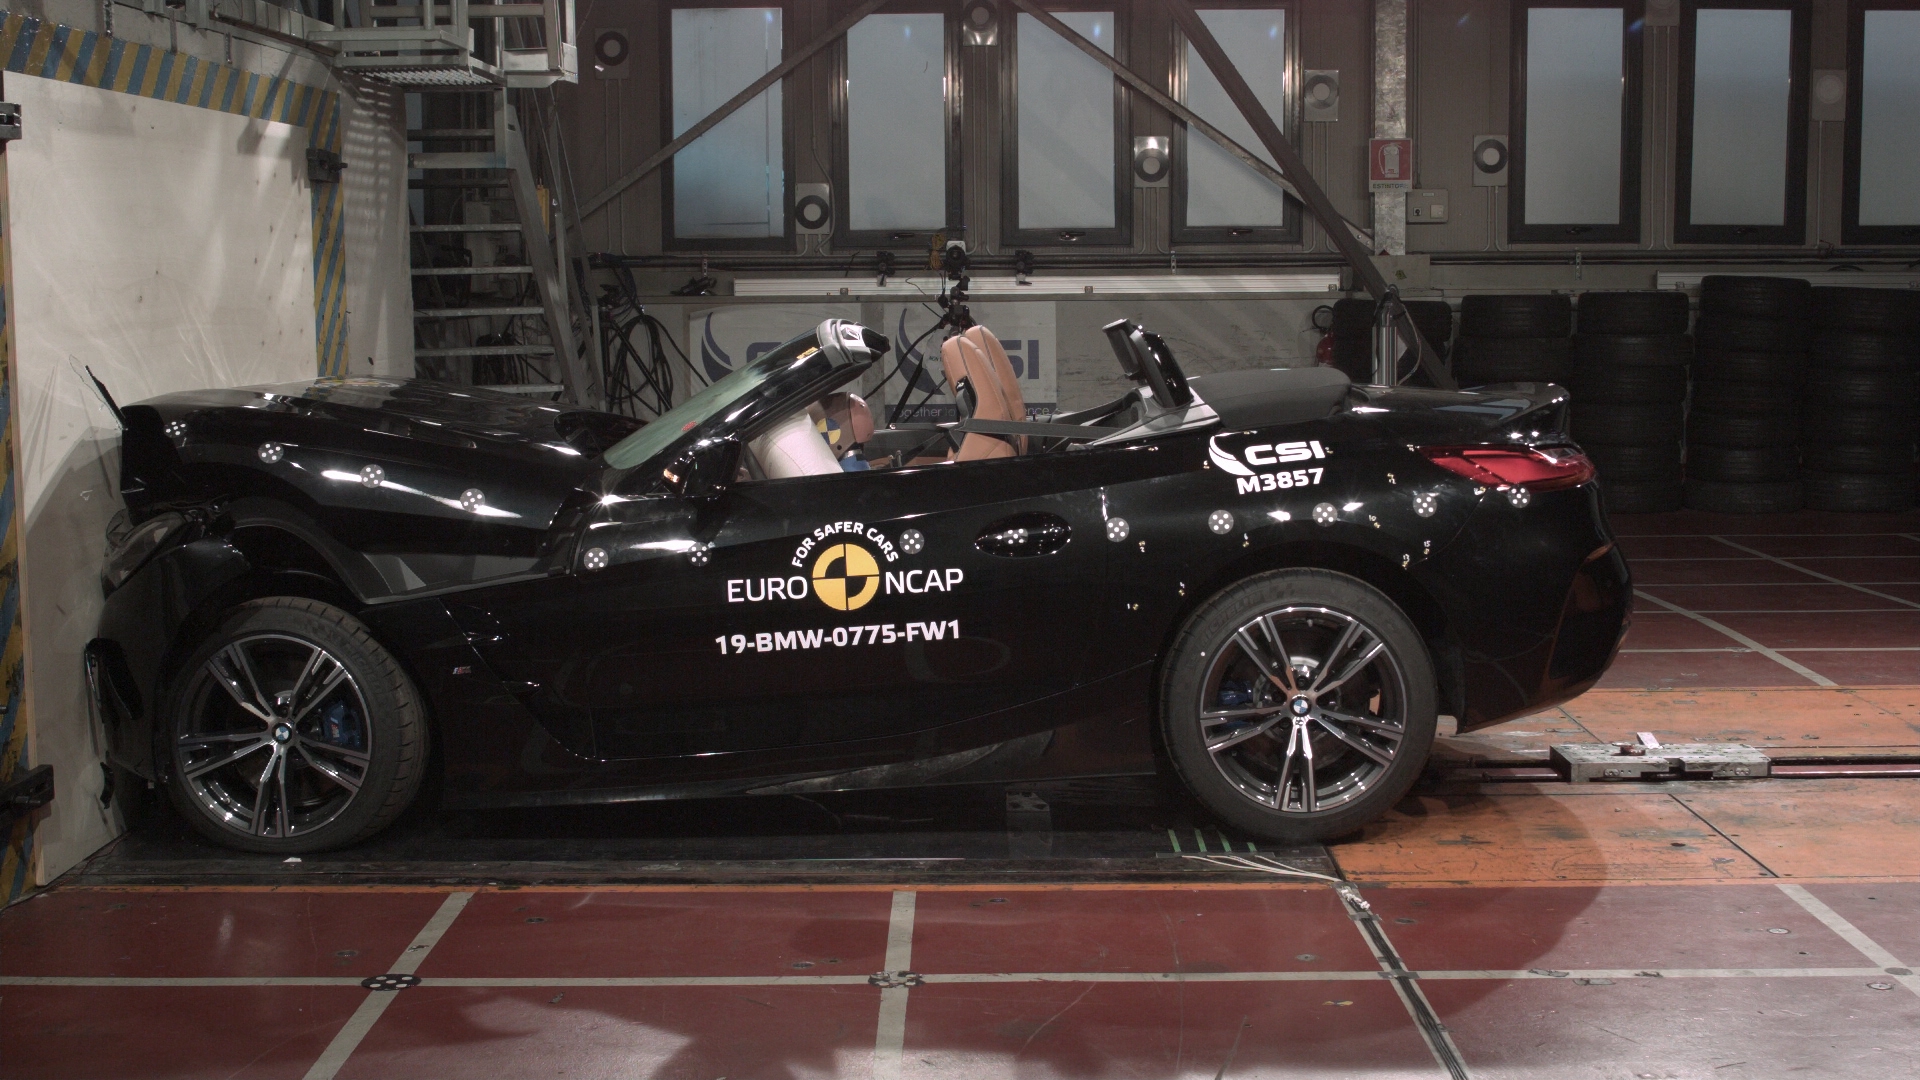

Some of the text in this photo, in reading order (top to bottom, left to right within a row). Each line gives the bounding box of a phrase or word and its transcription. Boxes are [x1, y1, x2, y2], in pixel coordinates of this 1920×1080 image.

[893, 407, 943, 419] gether
[1244, 440, 1326, 466] CSI
[1236, 467, 1324, 495] M3857
[791, 521, 899, 568] FOR SAFER CARS
[727, 568, 964, 602] EURO NCAP
[715, 620, 960, 655] 19-BMW-0775-FW1
